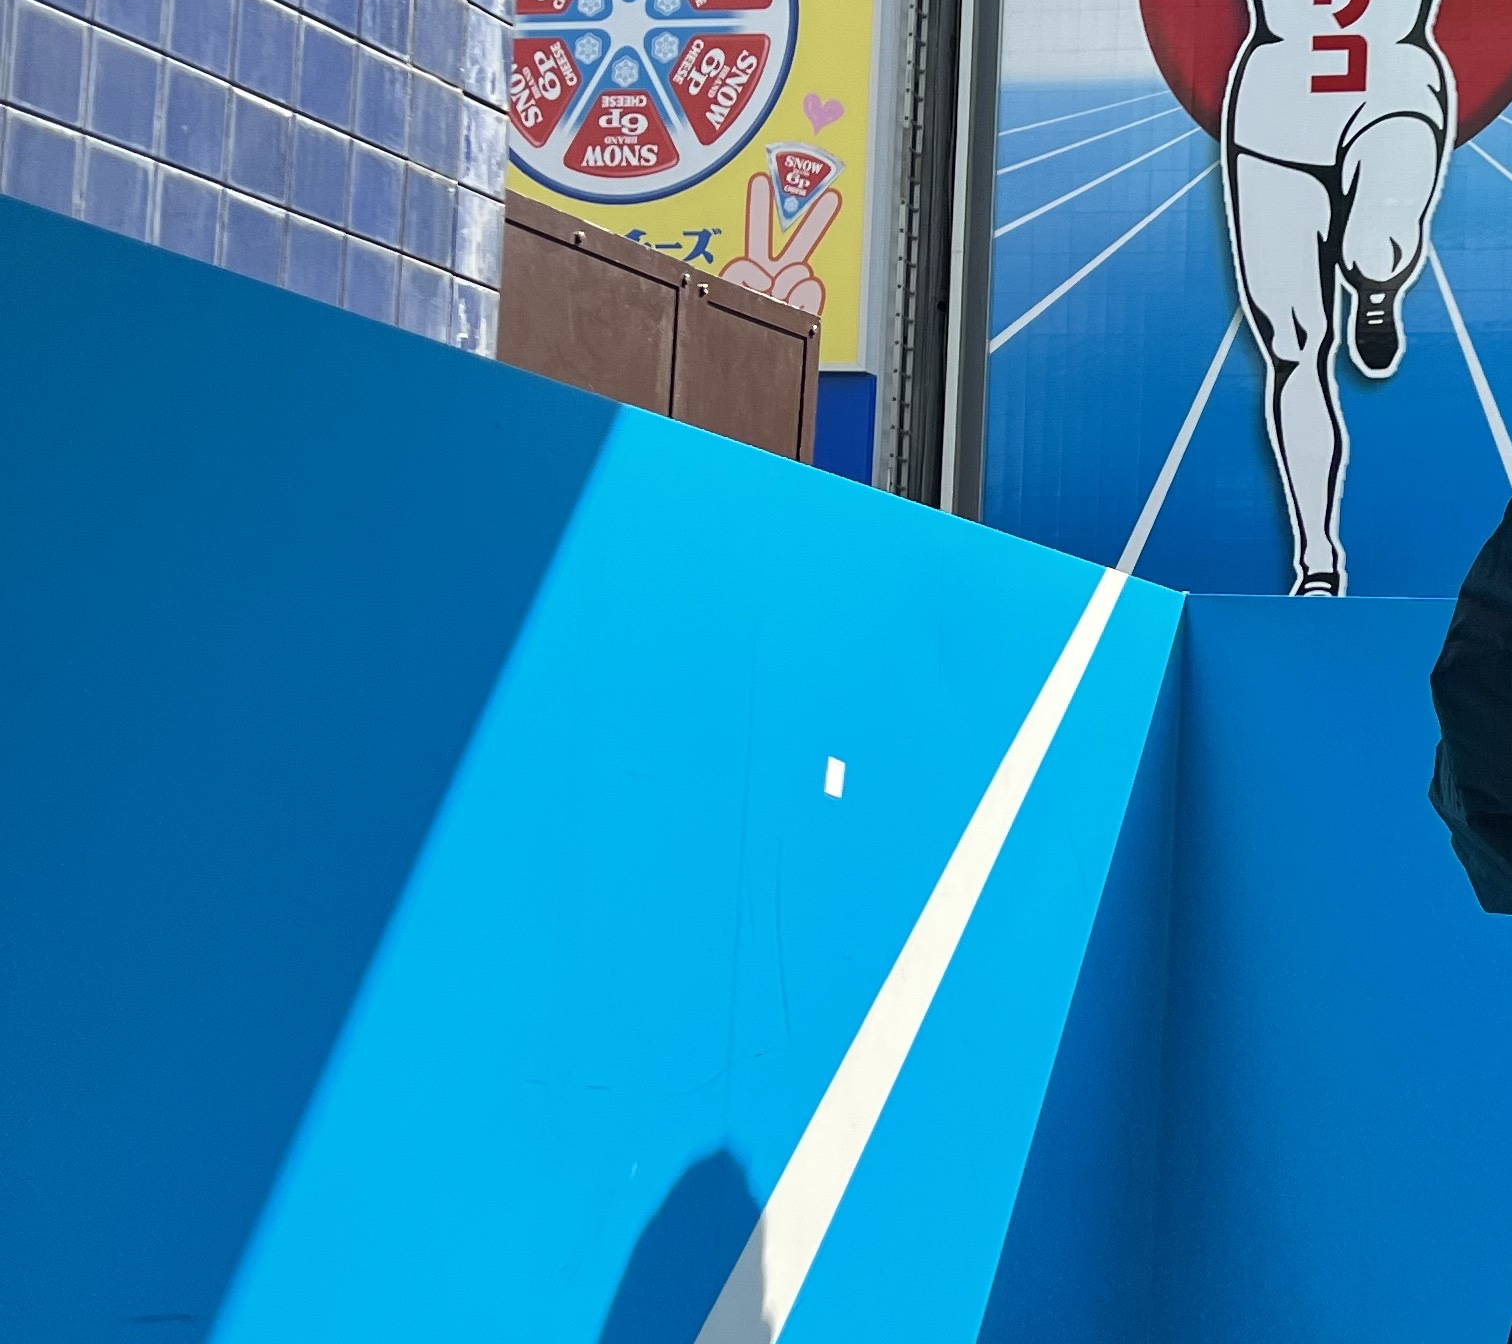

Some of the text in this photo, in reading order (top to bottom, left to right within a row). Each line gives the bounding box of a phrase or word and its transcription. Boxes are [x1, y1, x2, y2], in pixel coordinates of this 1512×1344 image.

[533, 50, 562, 101] 6P
[550, 41, 578, 87] CHEESE
[673, 39, 704, 85] CHEESE
[688, 47, 726, 96] 6P
[510, 63, 543, 129] SNO
[602, 95, 647, 109] CHEESE
[706, 50, 758, 131] SNOW
[598, 109, 648, 135] 6P
[581, 144, 659, 167] SNOW
[784, 155, 823, 174] SNOW
